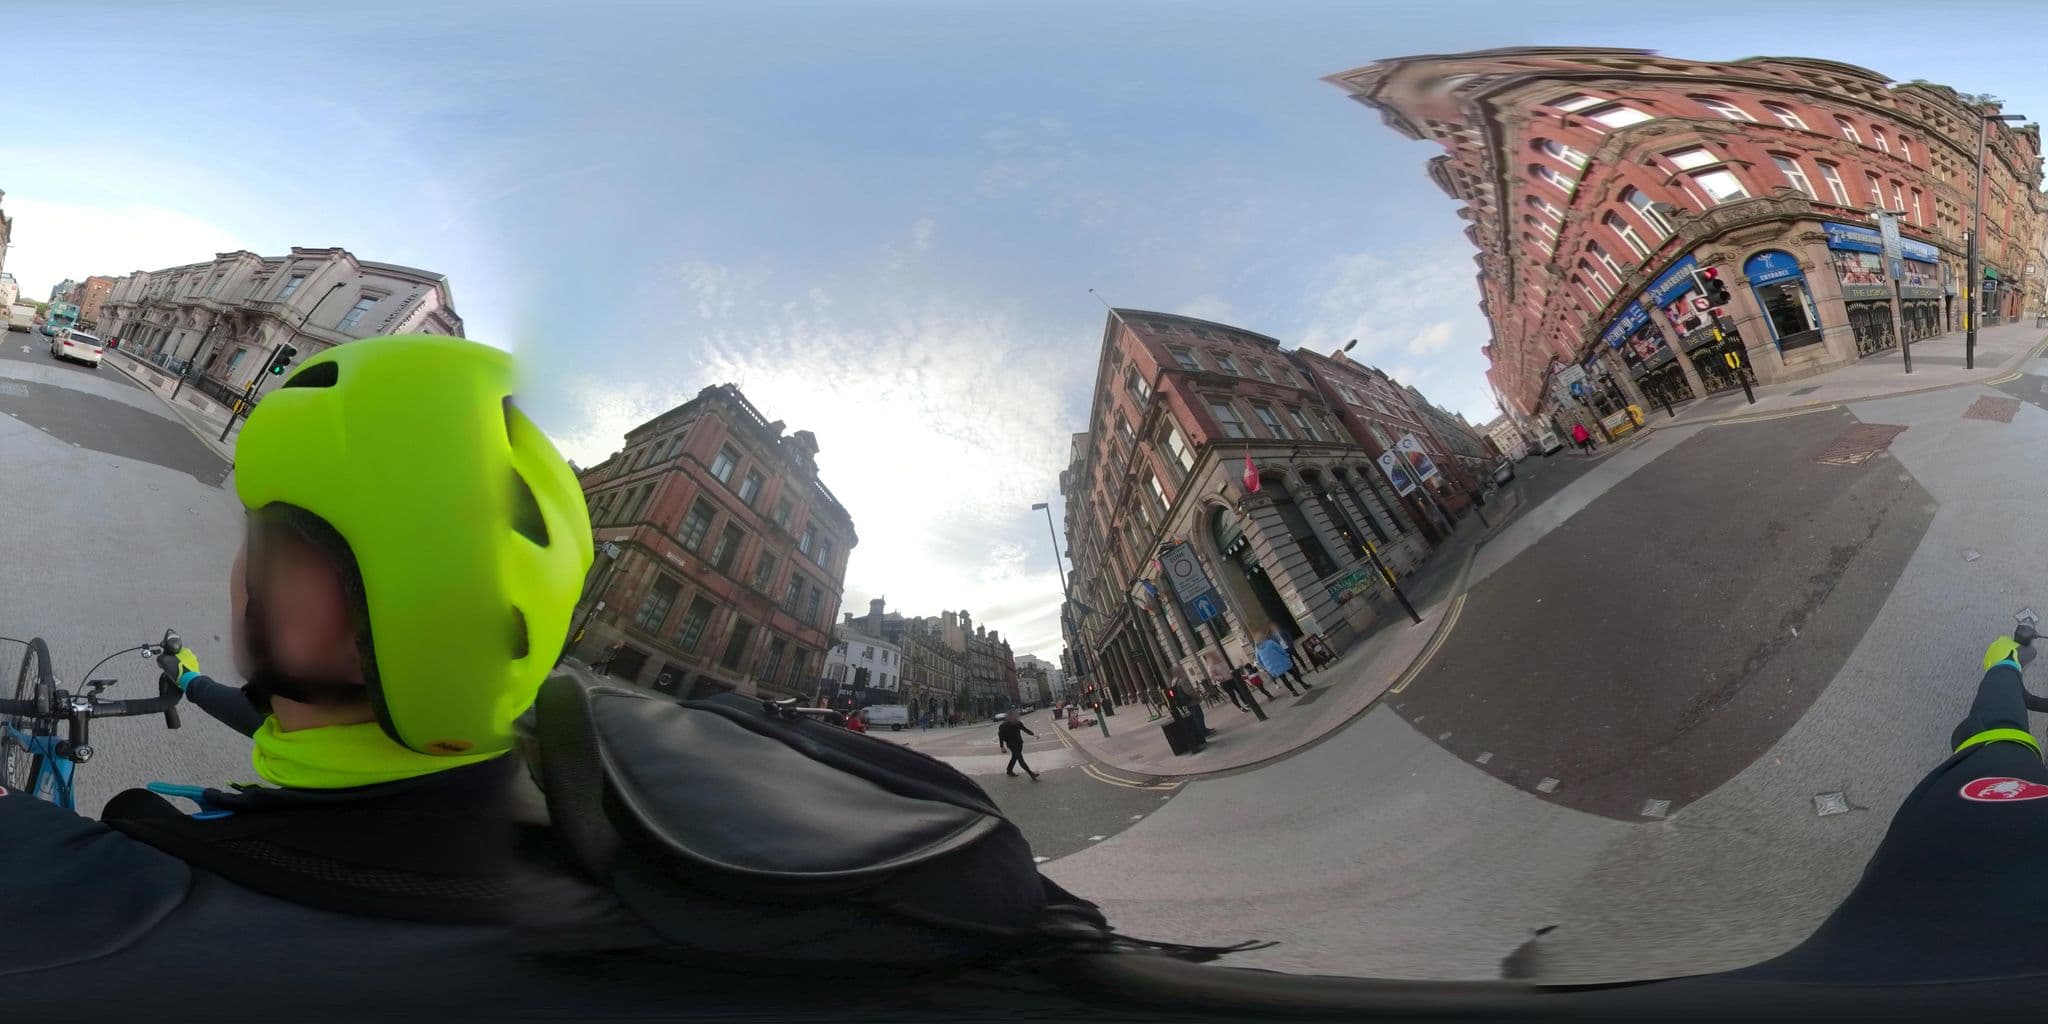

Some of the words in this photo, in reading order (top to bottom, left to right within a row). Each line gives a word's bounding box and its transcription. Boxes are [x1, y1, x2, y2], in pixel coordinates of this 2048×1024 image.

[1760, 270, 1789, 281] ENTRANCE
[1852, 289, 1866, 297] THE
[1686, 337, 1699, 346] THE
